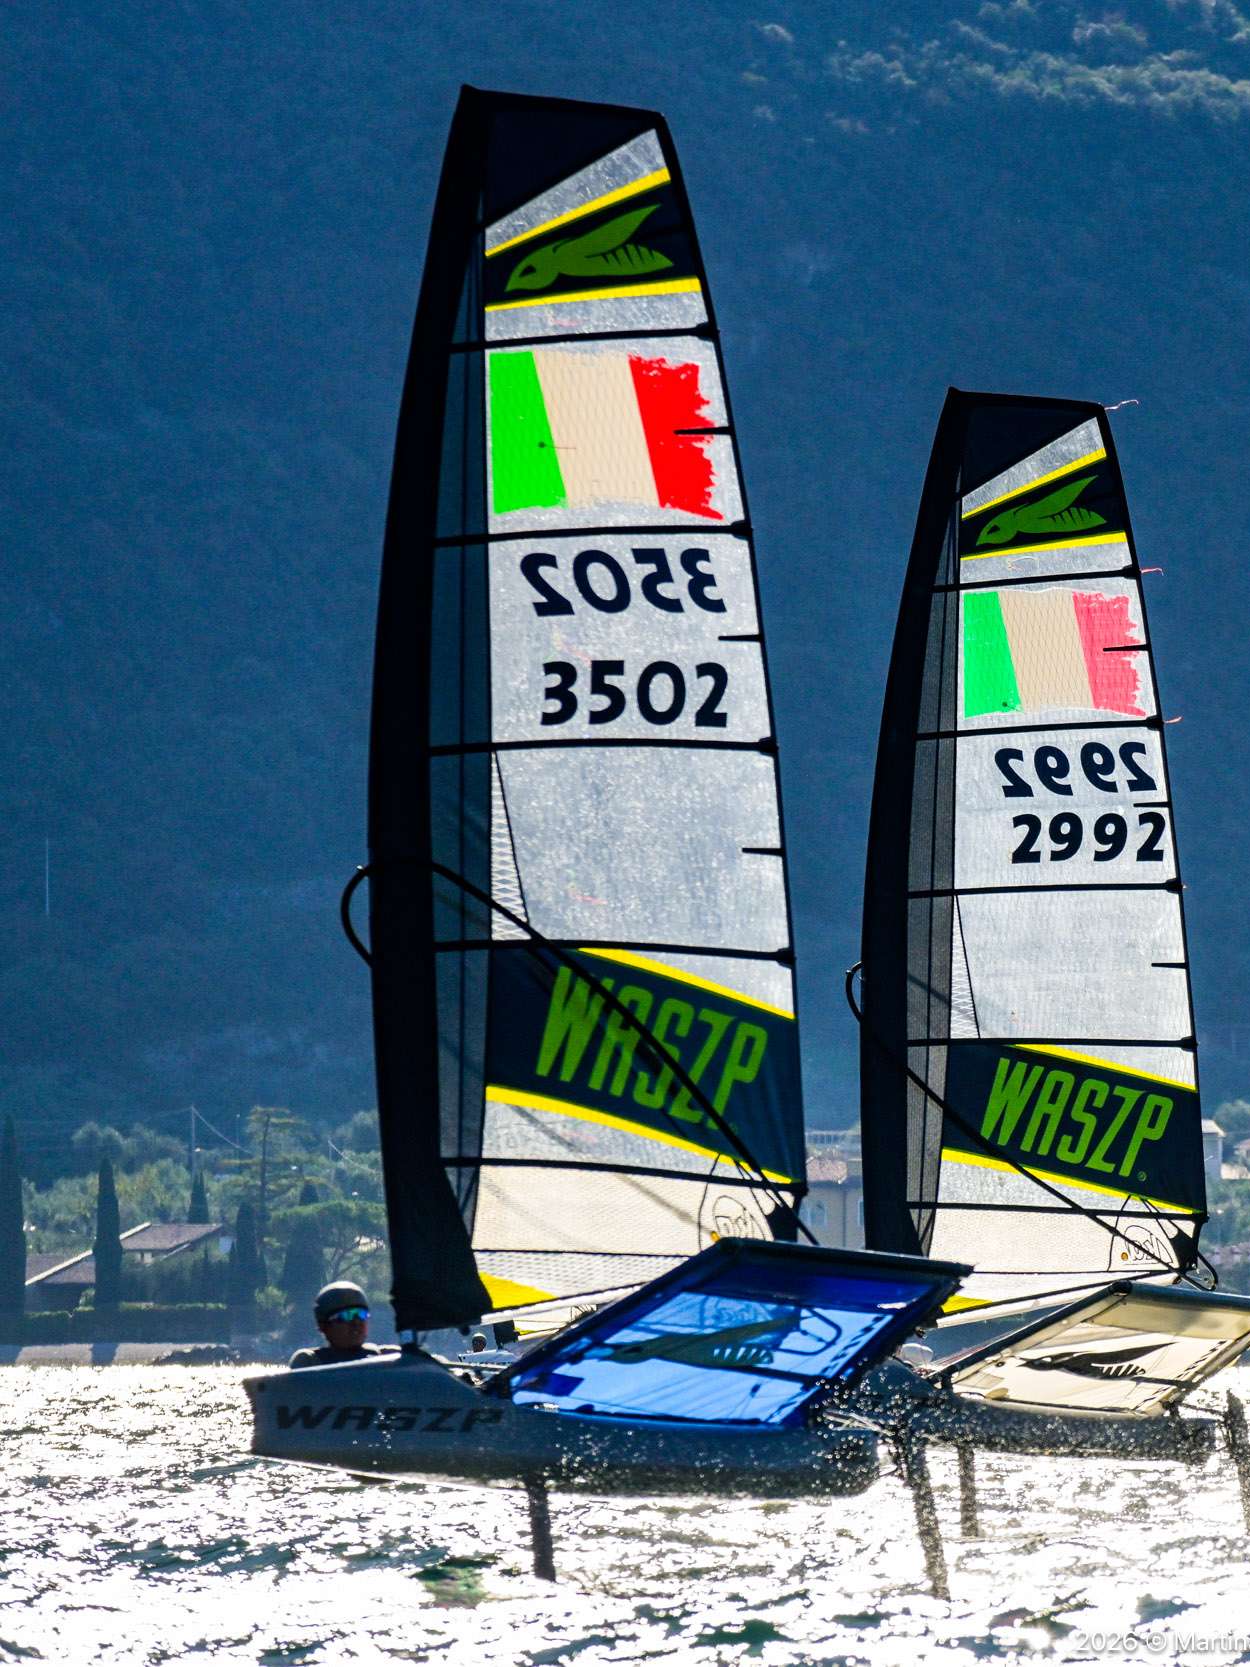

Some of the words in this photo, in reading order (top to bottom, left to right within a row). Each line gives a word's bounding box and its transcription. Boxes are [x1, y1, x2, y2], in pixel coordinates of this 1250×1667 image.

[540, 659, 729, 729] 3502
[1011, 810, 1167, 865] 2992
[535, 965, 768, 1127] WASZP
[979, 1056, 1175, 1178] WASZP
[275, 1405, 505, 1433] WASZP
